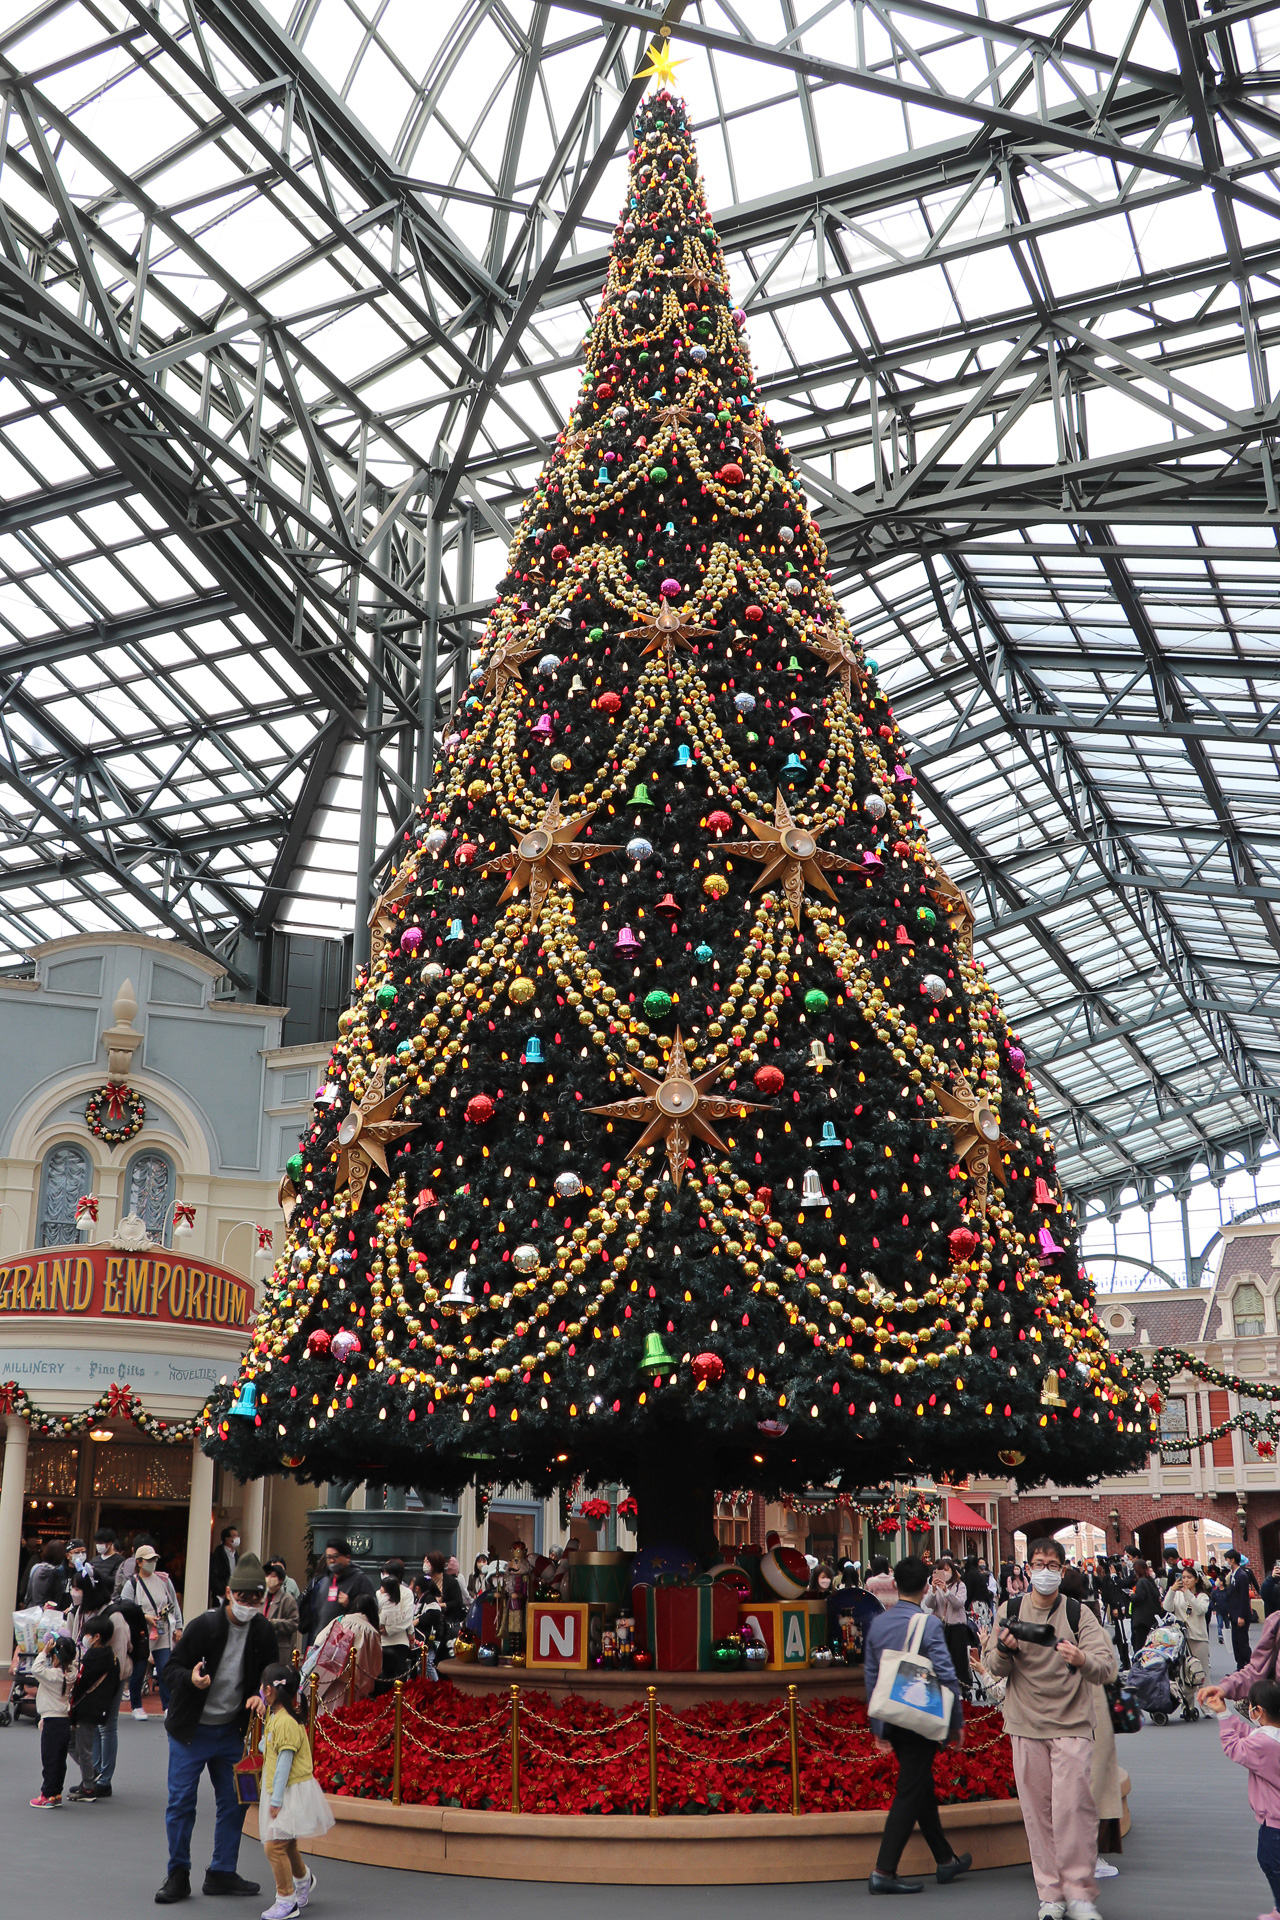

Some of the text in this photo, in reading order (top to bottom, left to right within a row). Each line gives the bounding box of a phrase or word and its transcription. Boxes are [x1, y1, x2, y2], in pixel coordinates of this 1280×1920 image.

[0, 1257, 247, 1326] GRAND EMPORIUM
[2, 1360, 217, 1386] MILLINERY Fine Gifts NOVELTIES
[540, 1615, 574, 1657] N
[785, 1614, 805, 1658] A
